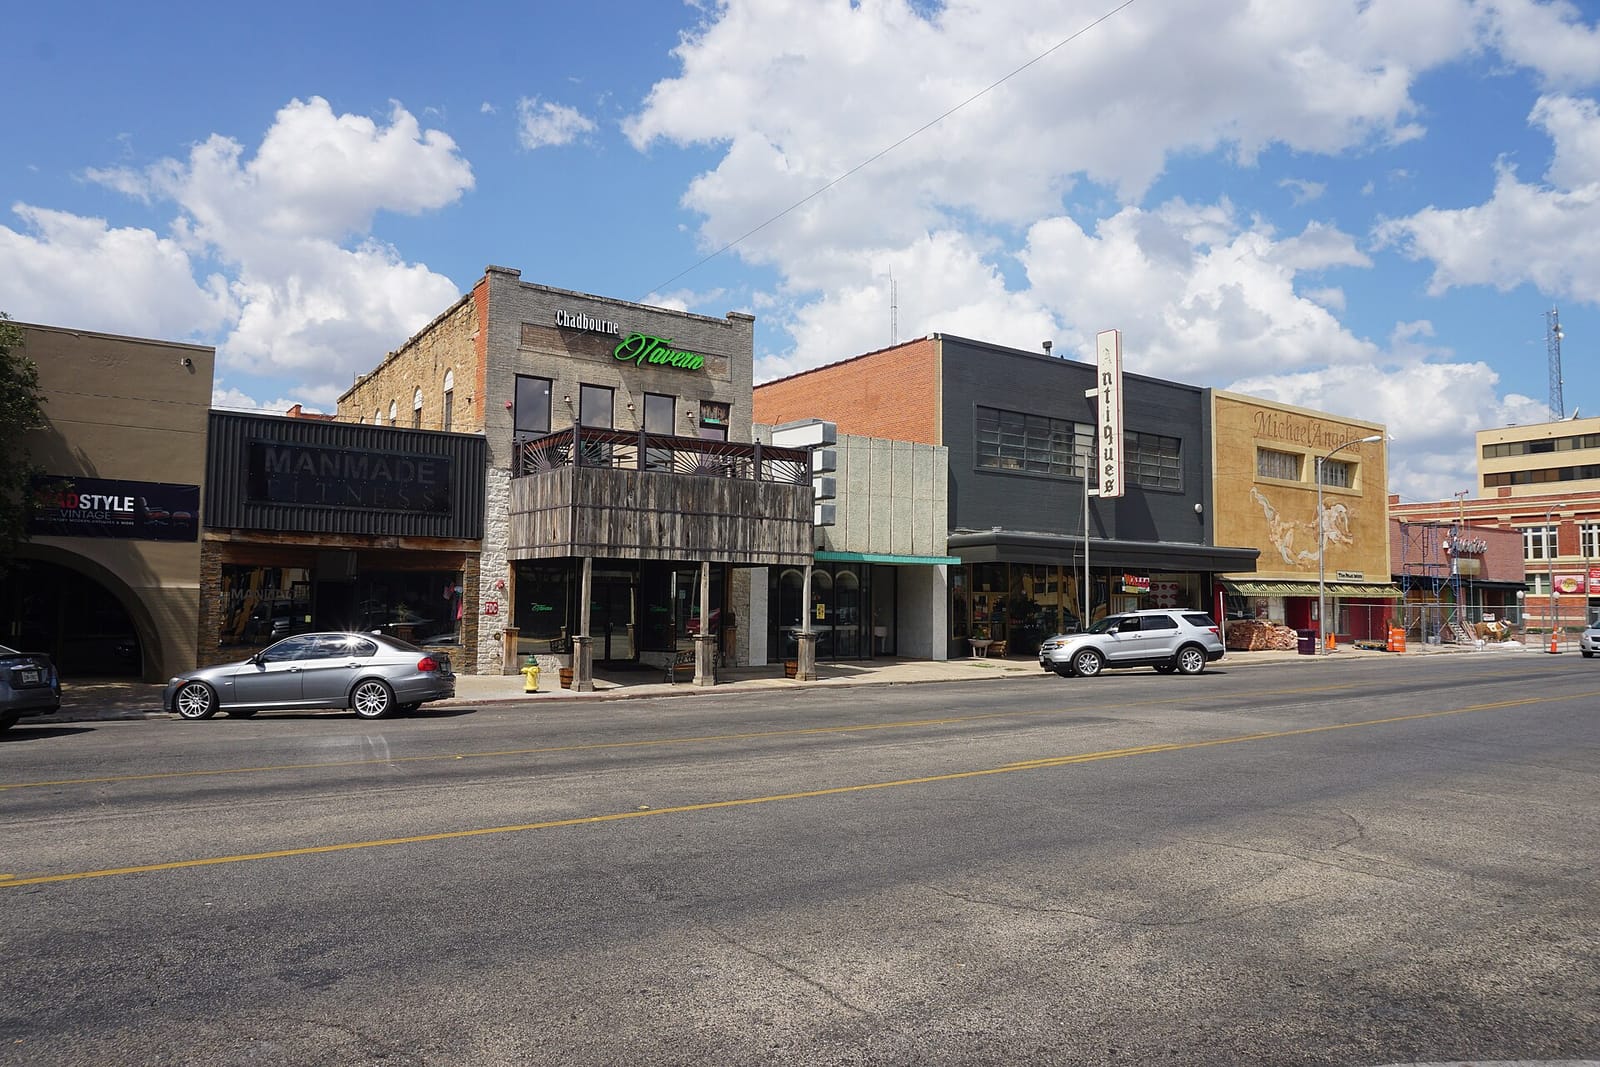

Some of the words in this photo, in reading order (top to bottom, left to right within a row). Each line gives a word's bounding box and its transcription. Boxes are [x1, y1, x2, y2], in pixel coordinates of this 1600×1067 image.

[556, 309, 619, 334] Chadbourne
[613, 331, 705, 370] Tavern
[1253, 410, 1312, 448] Michael
[264, 448, 435, 484] MANMADE
[60, 510, 111, 520] VINTAGE
[485, 603, 498, 614] FDC
